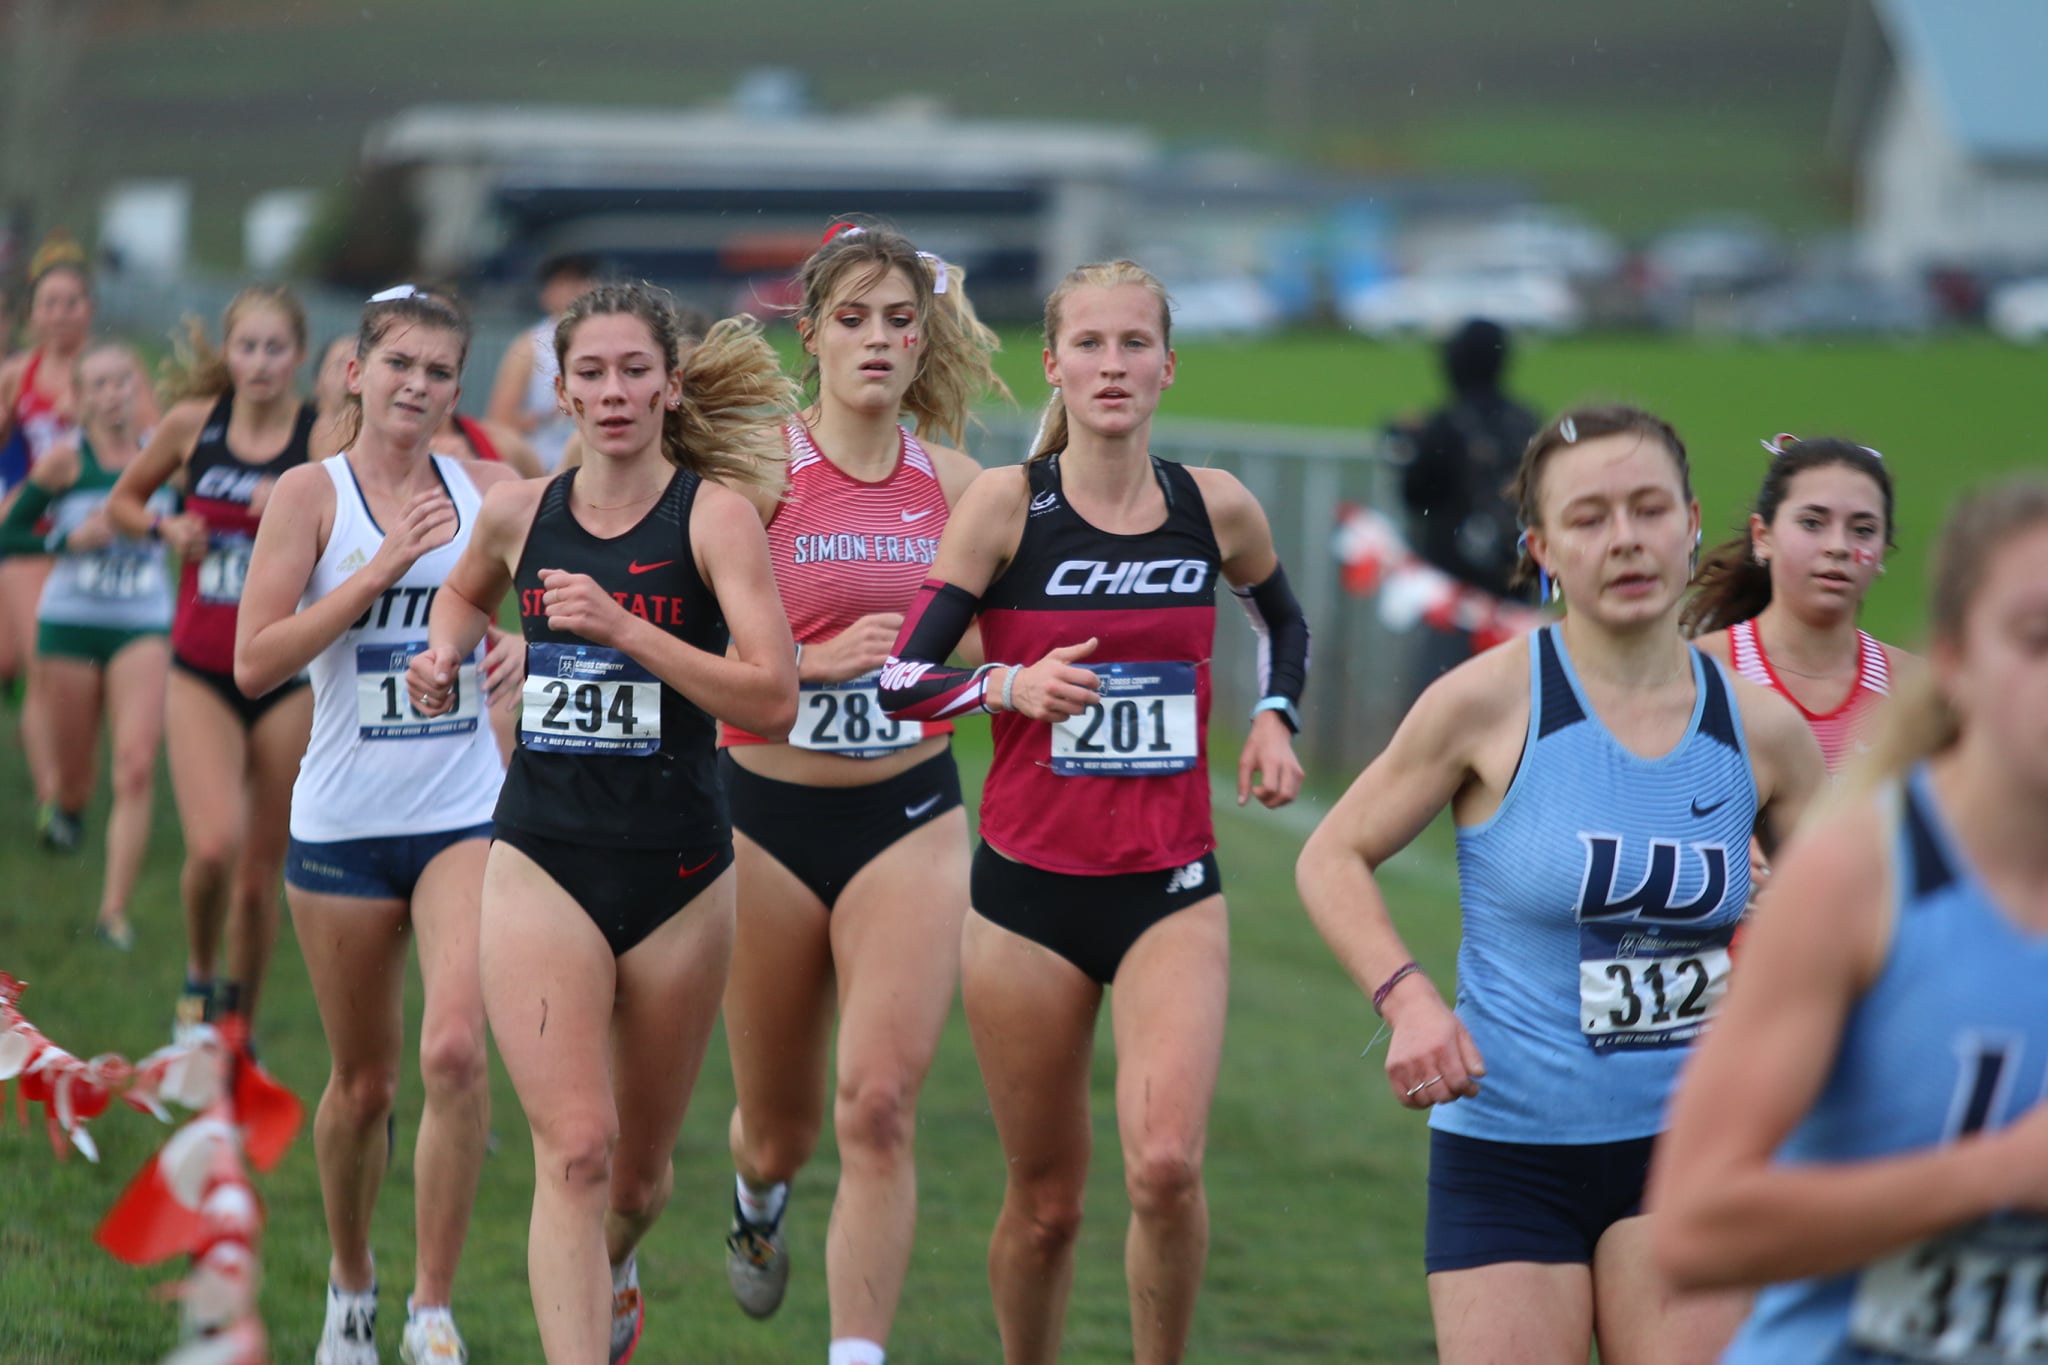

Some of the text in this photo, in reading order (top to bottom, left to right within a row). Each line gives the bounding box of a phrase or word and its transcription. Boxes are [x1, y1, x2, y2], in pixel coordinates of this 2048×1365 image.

[794, 534, 940, 565] SIMON FRASE
[1045, 559, 1208, 595] CHICO
[613, 591, 684, 625] TATE
[541, 681, 638, 736] 294
[1075, 699, 1172, 754] 201
[1605, 958, 1710, 1028] 312
